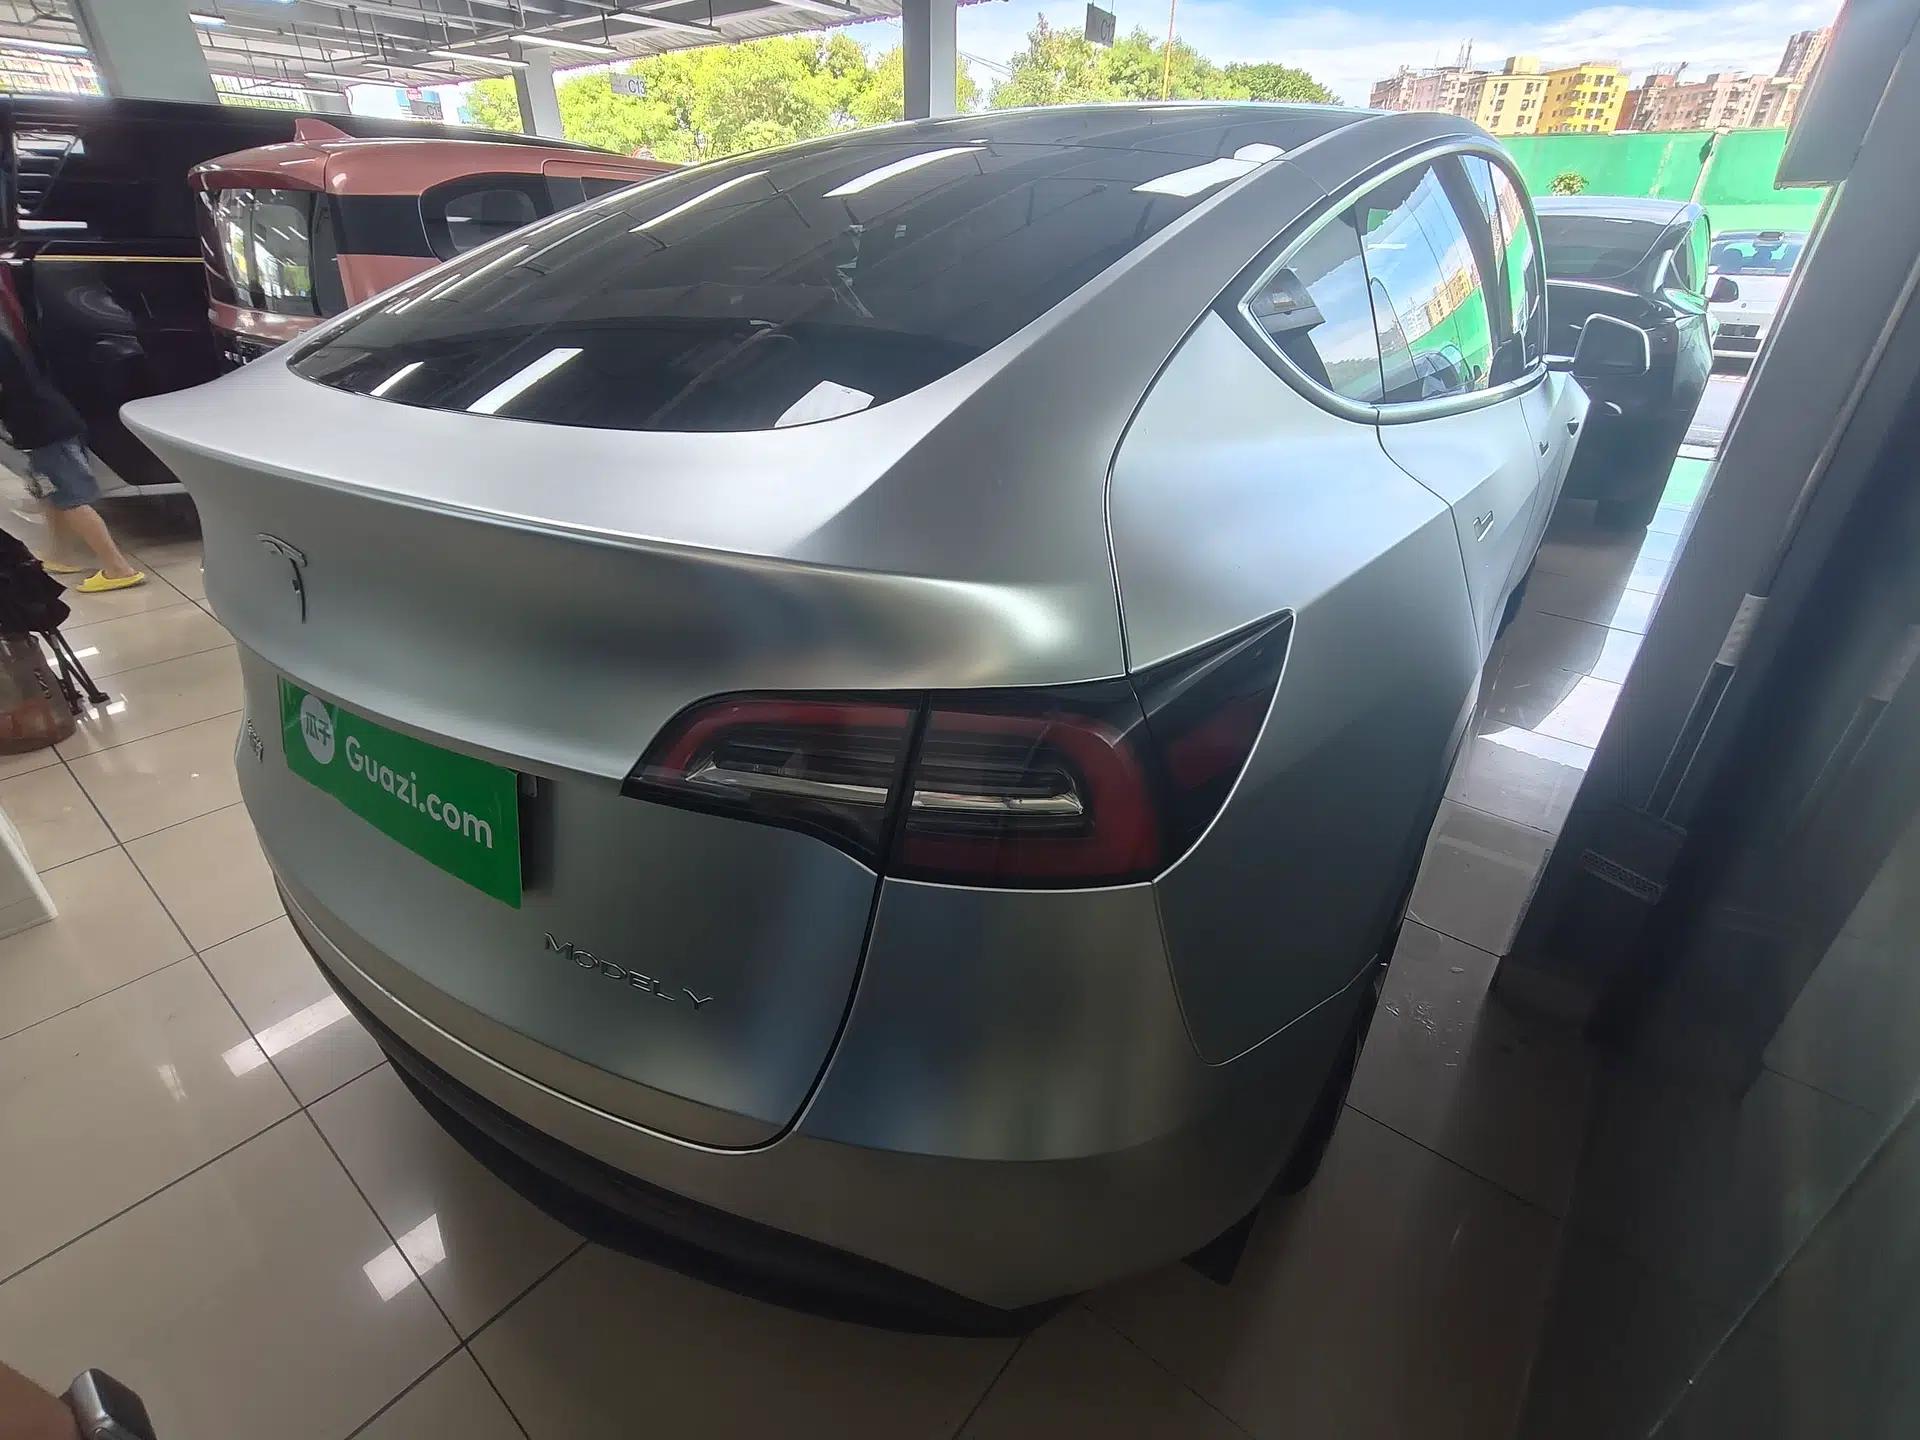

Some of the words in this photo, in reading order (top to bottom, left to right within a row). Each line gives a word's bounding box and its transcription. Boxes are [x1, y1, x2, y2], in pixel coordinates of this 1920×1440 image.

[628, 79, 646, 95] C13
[345, 735, 493, 849] Guazi.com
[544, 931, 675, 1001] MODEL
[682, 987, 714, 1010] Y
